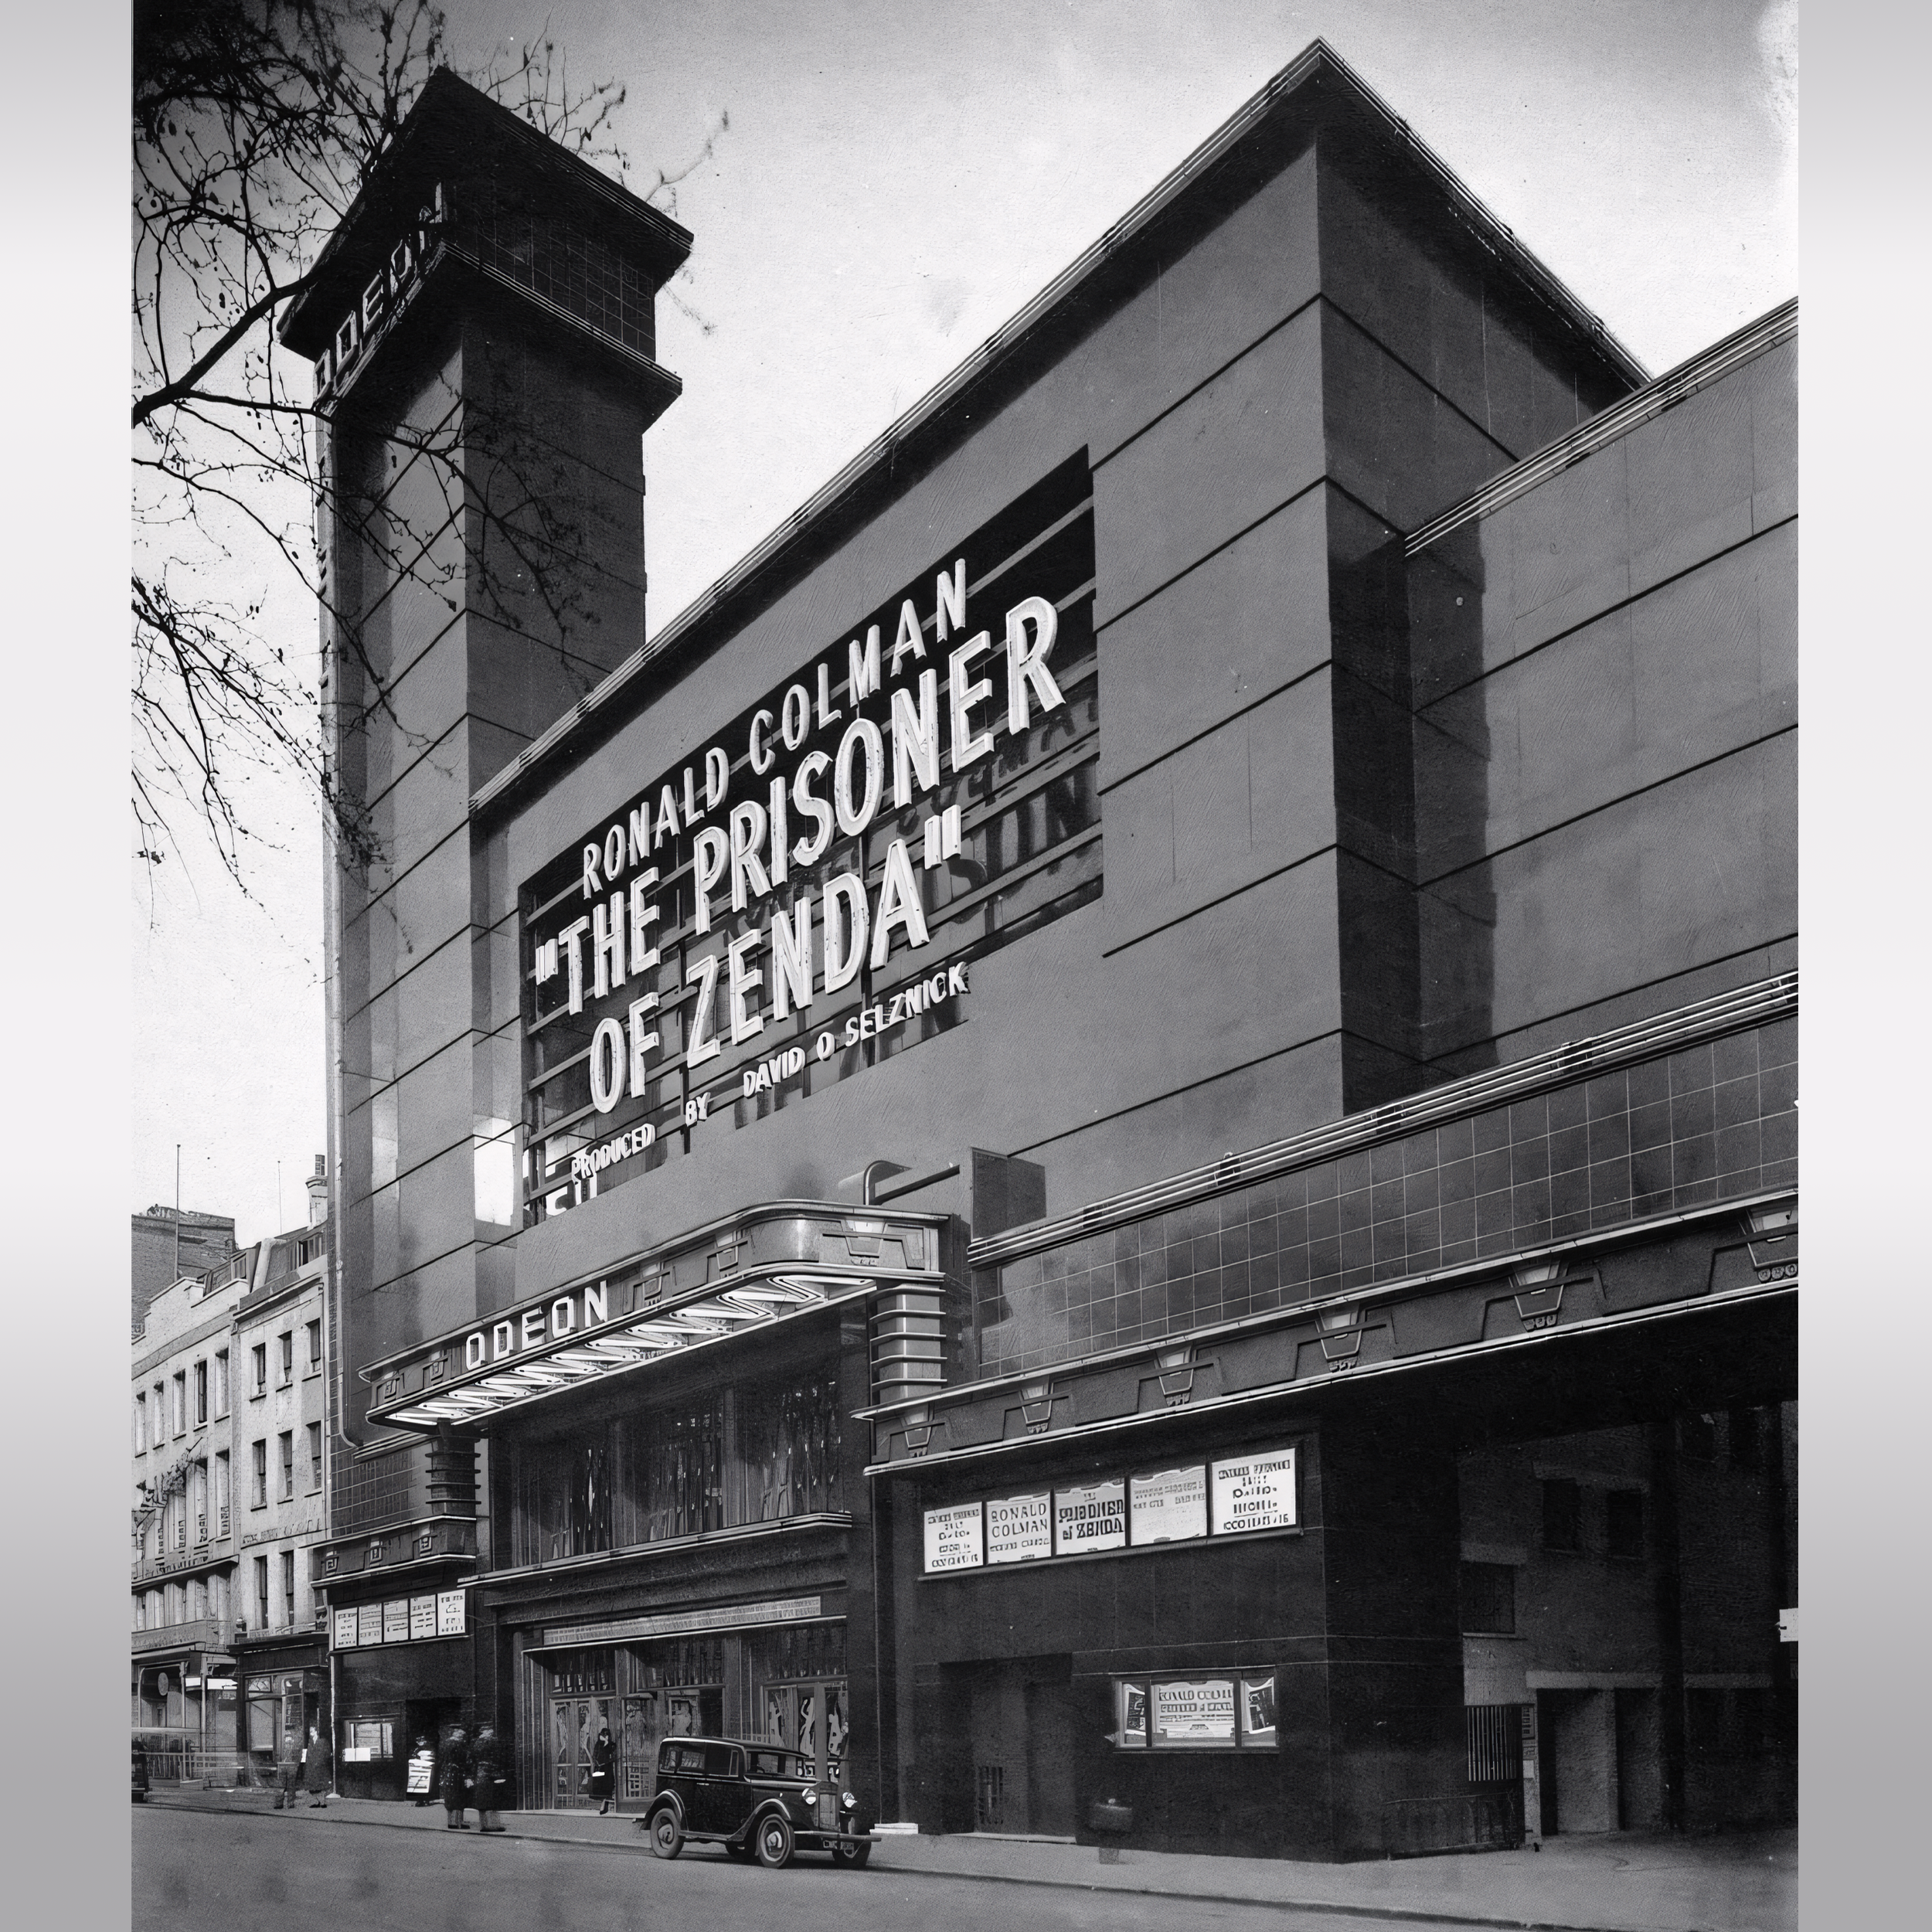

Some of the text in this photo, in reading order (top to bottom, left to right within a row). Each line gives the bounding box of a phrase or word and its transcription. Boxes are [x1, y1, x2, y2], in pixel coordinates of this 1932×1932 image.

[535, 596, 1066, 1015] "THE PRISONER
[583, 558, 965, 900] RONALD COLMAN
[571, 1123, 656, 1182] PRODUCED
[685, 1092, 711, 1127] BY
[743, 1046, 806, 1098] DAVID
[845, 961, 971, 1047] SELZNICK
[589, 804, 962, 1114] OF ZENDA"
[466, 1280, 607, 1370] ODEON
